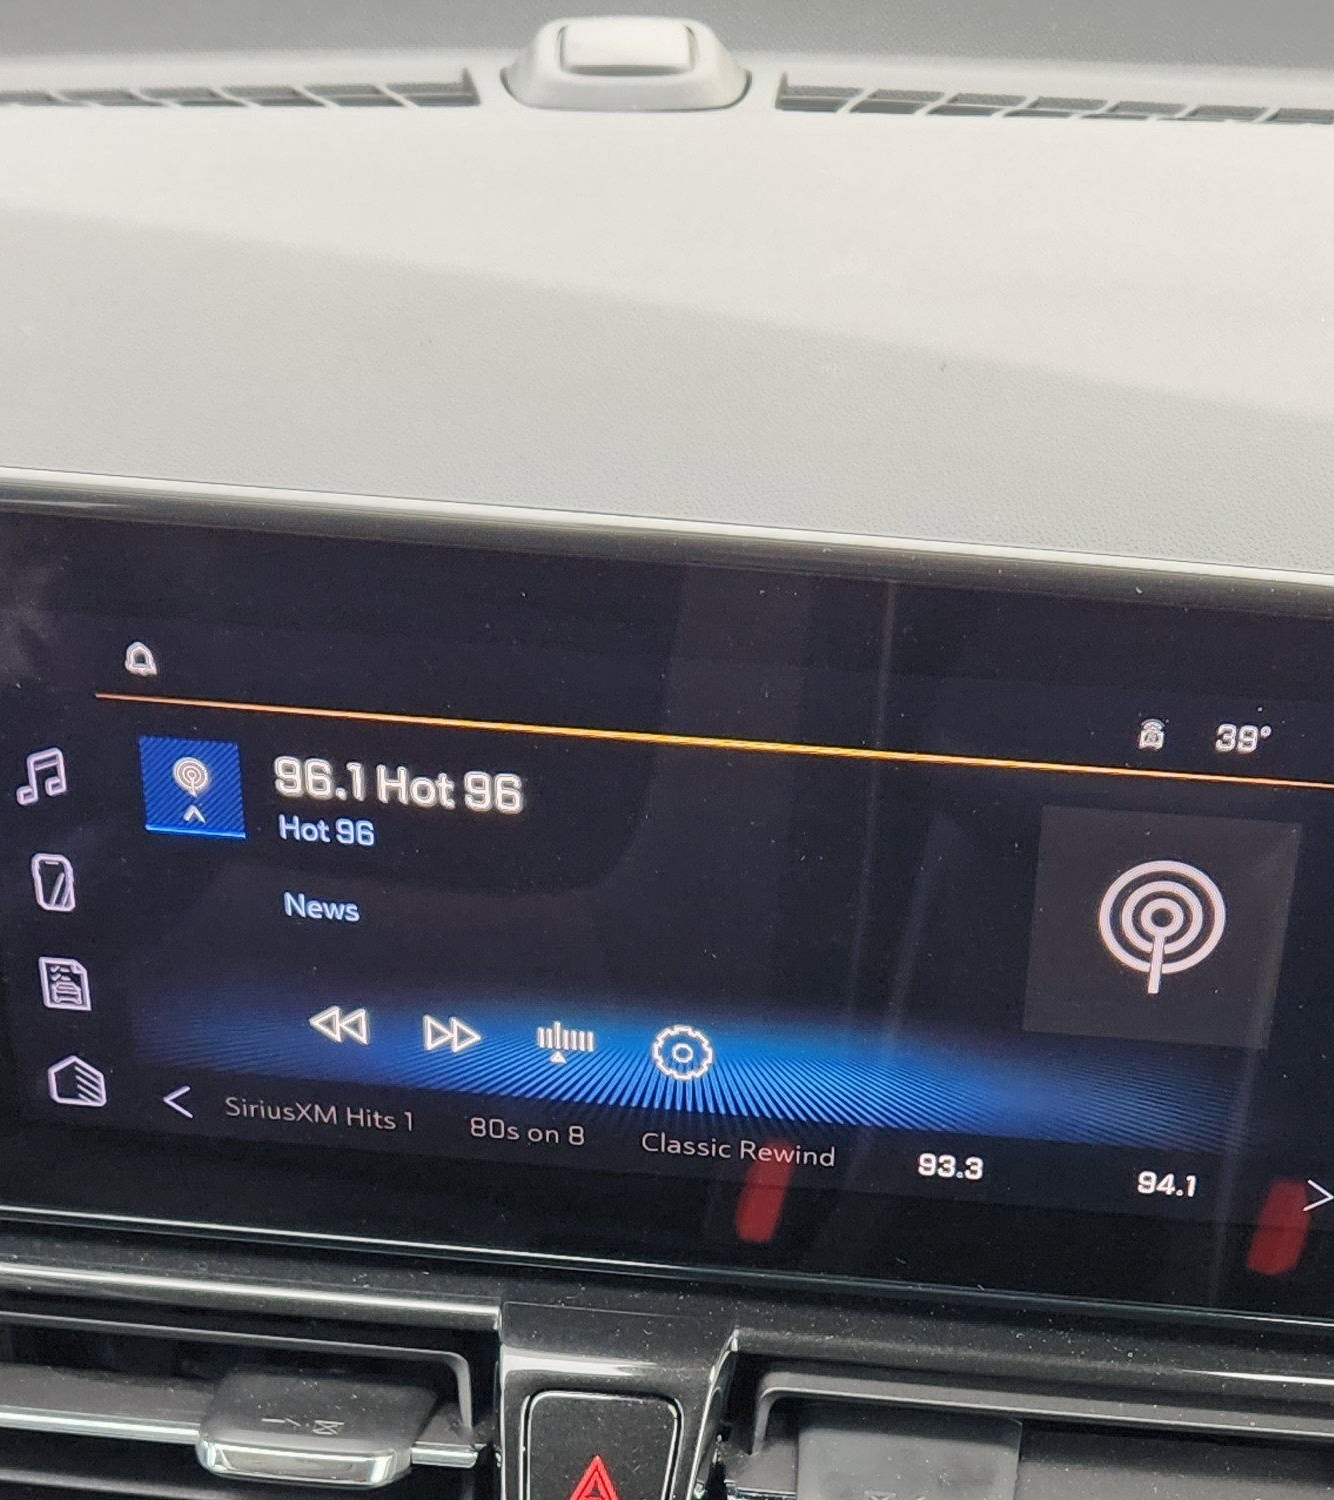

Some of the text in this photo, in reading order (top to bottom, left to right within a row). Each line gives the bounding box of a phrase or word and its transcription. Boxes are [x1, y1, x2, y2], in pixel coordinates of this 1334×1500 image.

[1215, 722, 1272, 753] 39°
[274, 755, 524, 815] 96.1 Hot 96
[277, 813, 376, 847] Hot 96
[283, 891, 360, 923] News
[225, 1097, 414, 1132] SiriusXM Hits 1
[470, 1117, 586, 1146] 80s on 8
[641, 1132, 836, 1168] Classic Rewind
[917, 1152, 985, 1180] 93.3
[1136, 1171, 1198, 1198] 94.1
